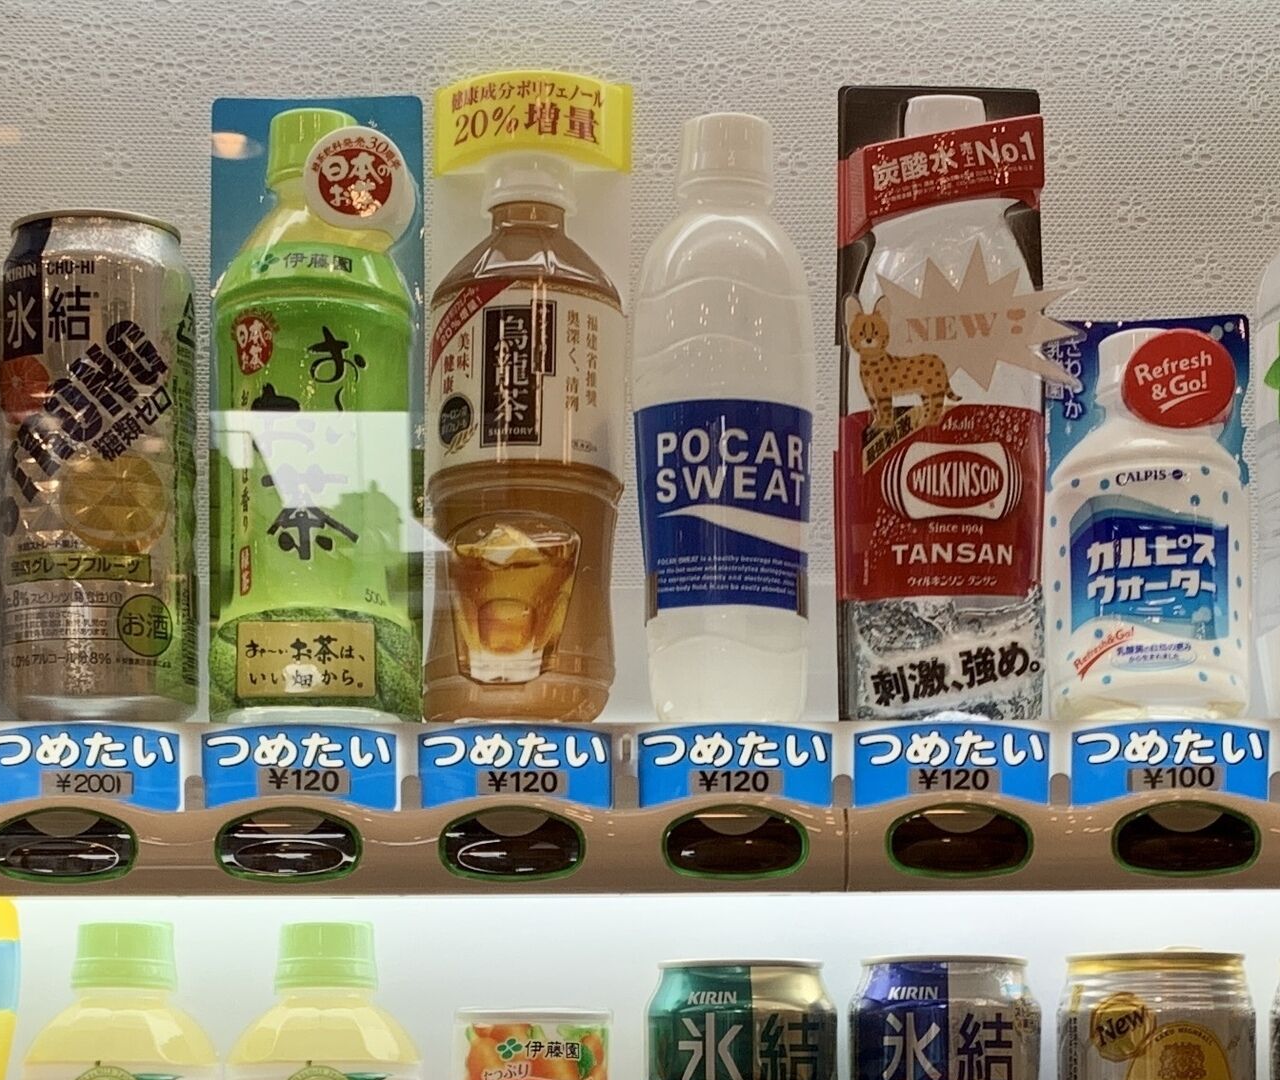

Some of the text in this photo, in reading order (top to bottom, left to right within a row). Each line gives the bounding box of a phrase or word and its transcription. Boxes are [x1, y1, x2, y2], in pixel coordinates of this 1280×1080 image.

[451, 79, 604, 113] 健康成分ポリフェノール
[454, 104, 600, 146] 20%増量
[4, 263, 38, 284] KIRIN
[46, 260, 95, 277] CHU-HI
[283, 252, 353, 274] 伊藤園
[493, 315, 531, 424] 烏龍茶
[1133, 350, 1213, 386] Refresh
[656, 465, 805, 507] SWEAT
[912, 461, 1001, 499] WILKINSON
[1116, 469, 1167, 487] CALPIS
[892, 544, 1014, 566] TANSAN
[1086, 533, 1217, 577] カルピス
[870, 641, 1041, 707] 刺激、強め。
[857, 730, 1046, 767] つめたい
[268, 767, 340, 794] ¥120
[486, 770, 558, 794] ¥120
[698, 769, 770, 794] ¥120
[918, 767, 991, 792] ¥120
[1142, 765, 1216, 790] ¥100
[687, 990, 738, 1005] KIRIN
[888, 985, 939, 1001] KIRIN
[524, 1040, 581, 1060] 伊藤園
